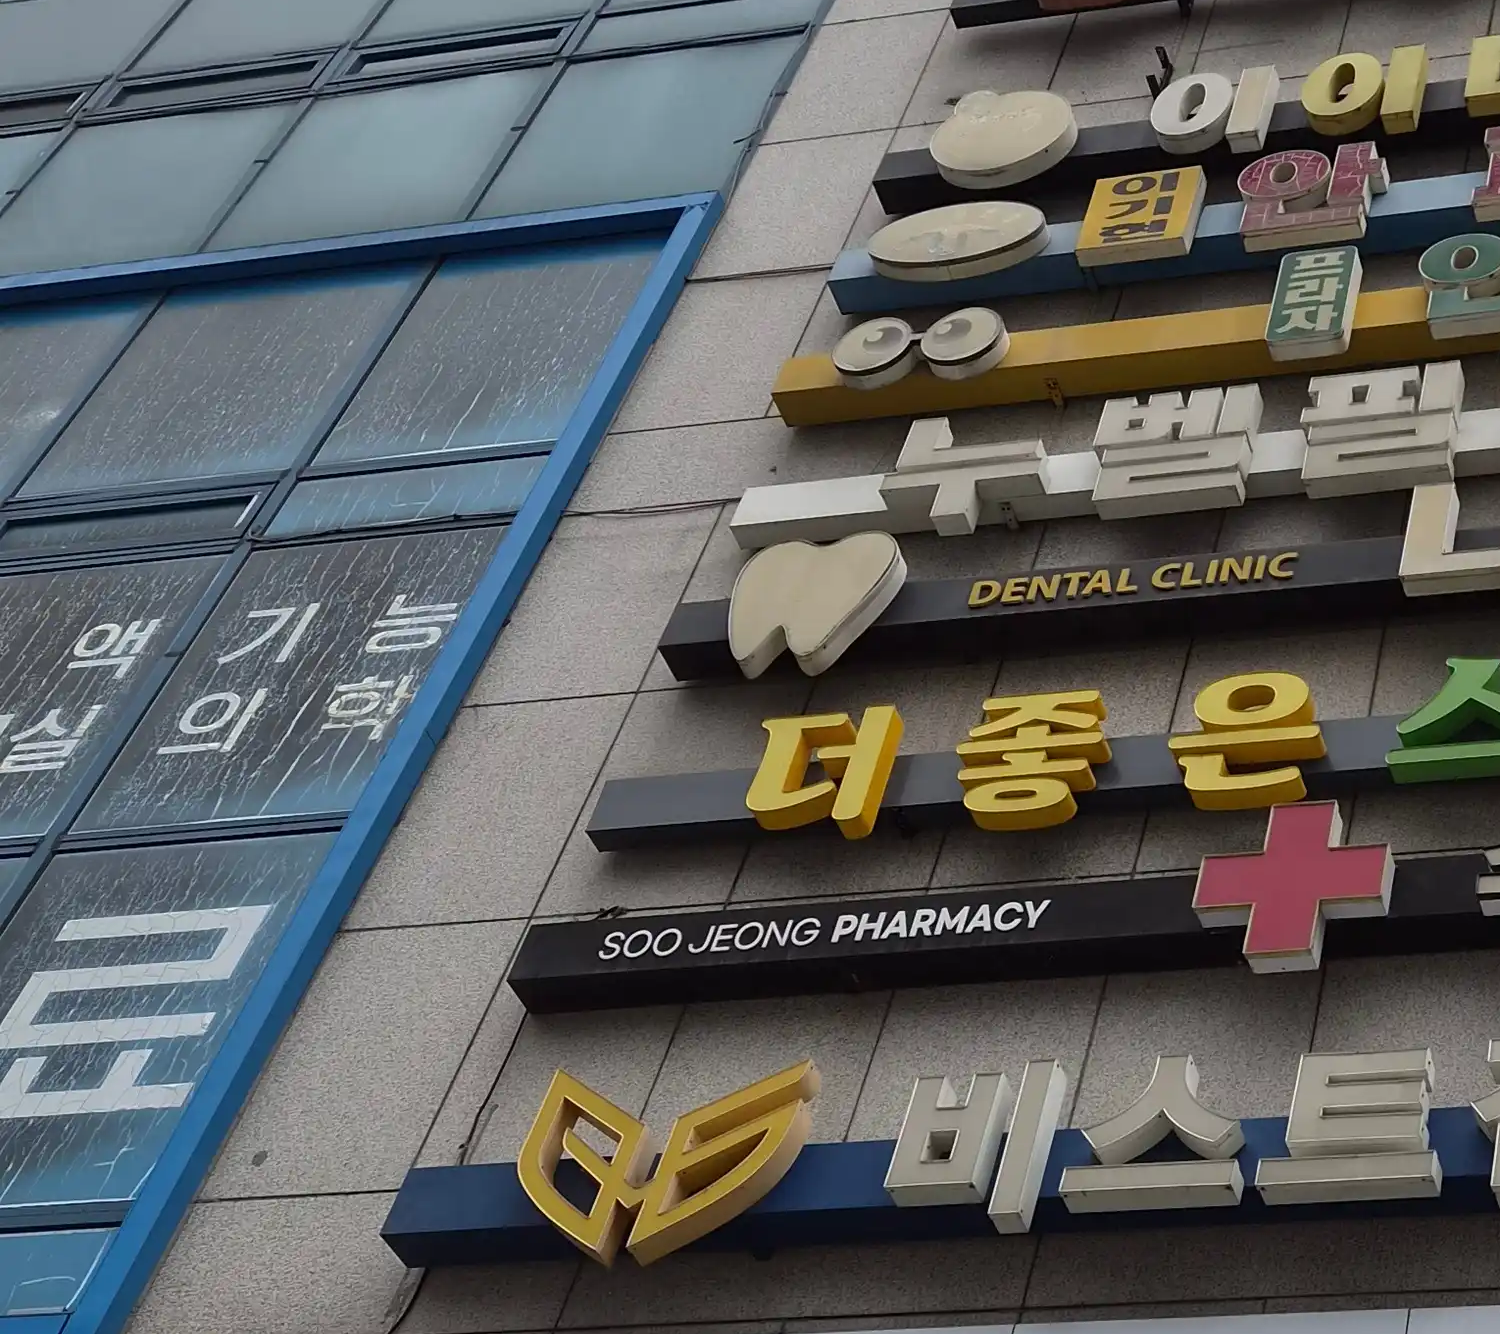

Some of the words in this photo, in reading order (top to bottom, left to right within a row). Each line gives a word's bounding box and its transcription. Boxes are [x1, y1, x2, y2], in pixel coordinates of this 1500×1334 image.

[1274, 250, 1347, 333] 프라자
[966, 567, 1138, 608] DENTAL
[1151, 551, 1300, 591] CLINIC
[217, 594, 458, 667] 기능
[157, 675, 417, 754] 의학
[598, 927, 682, 961] SOO
[688, 917, 821, 954] JEONG
[830, 899, 1052, 944] PHARMACY
